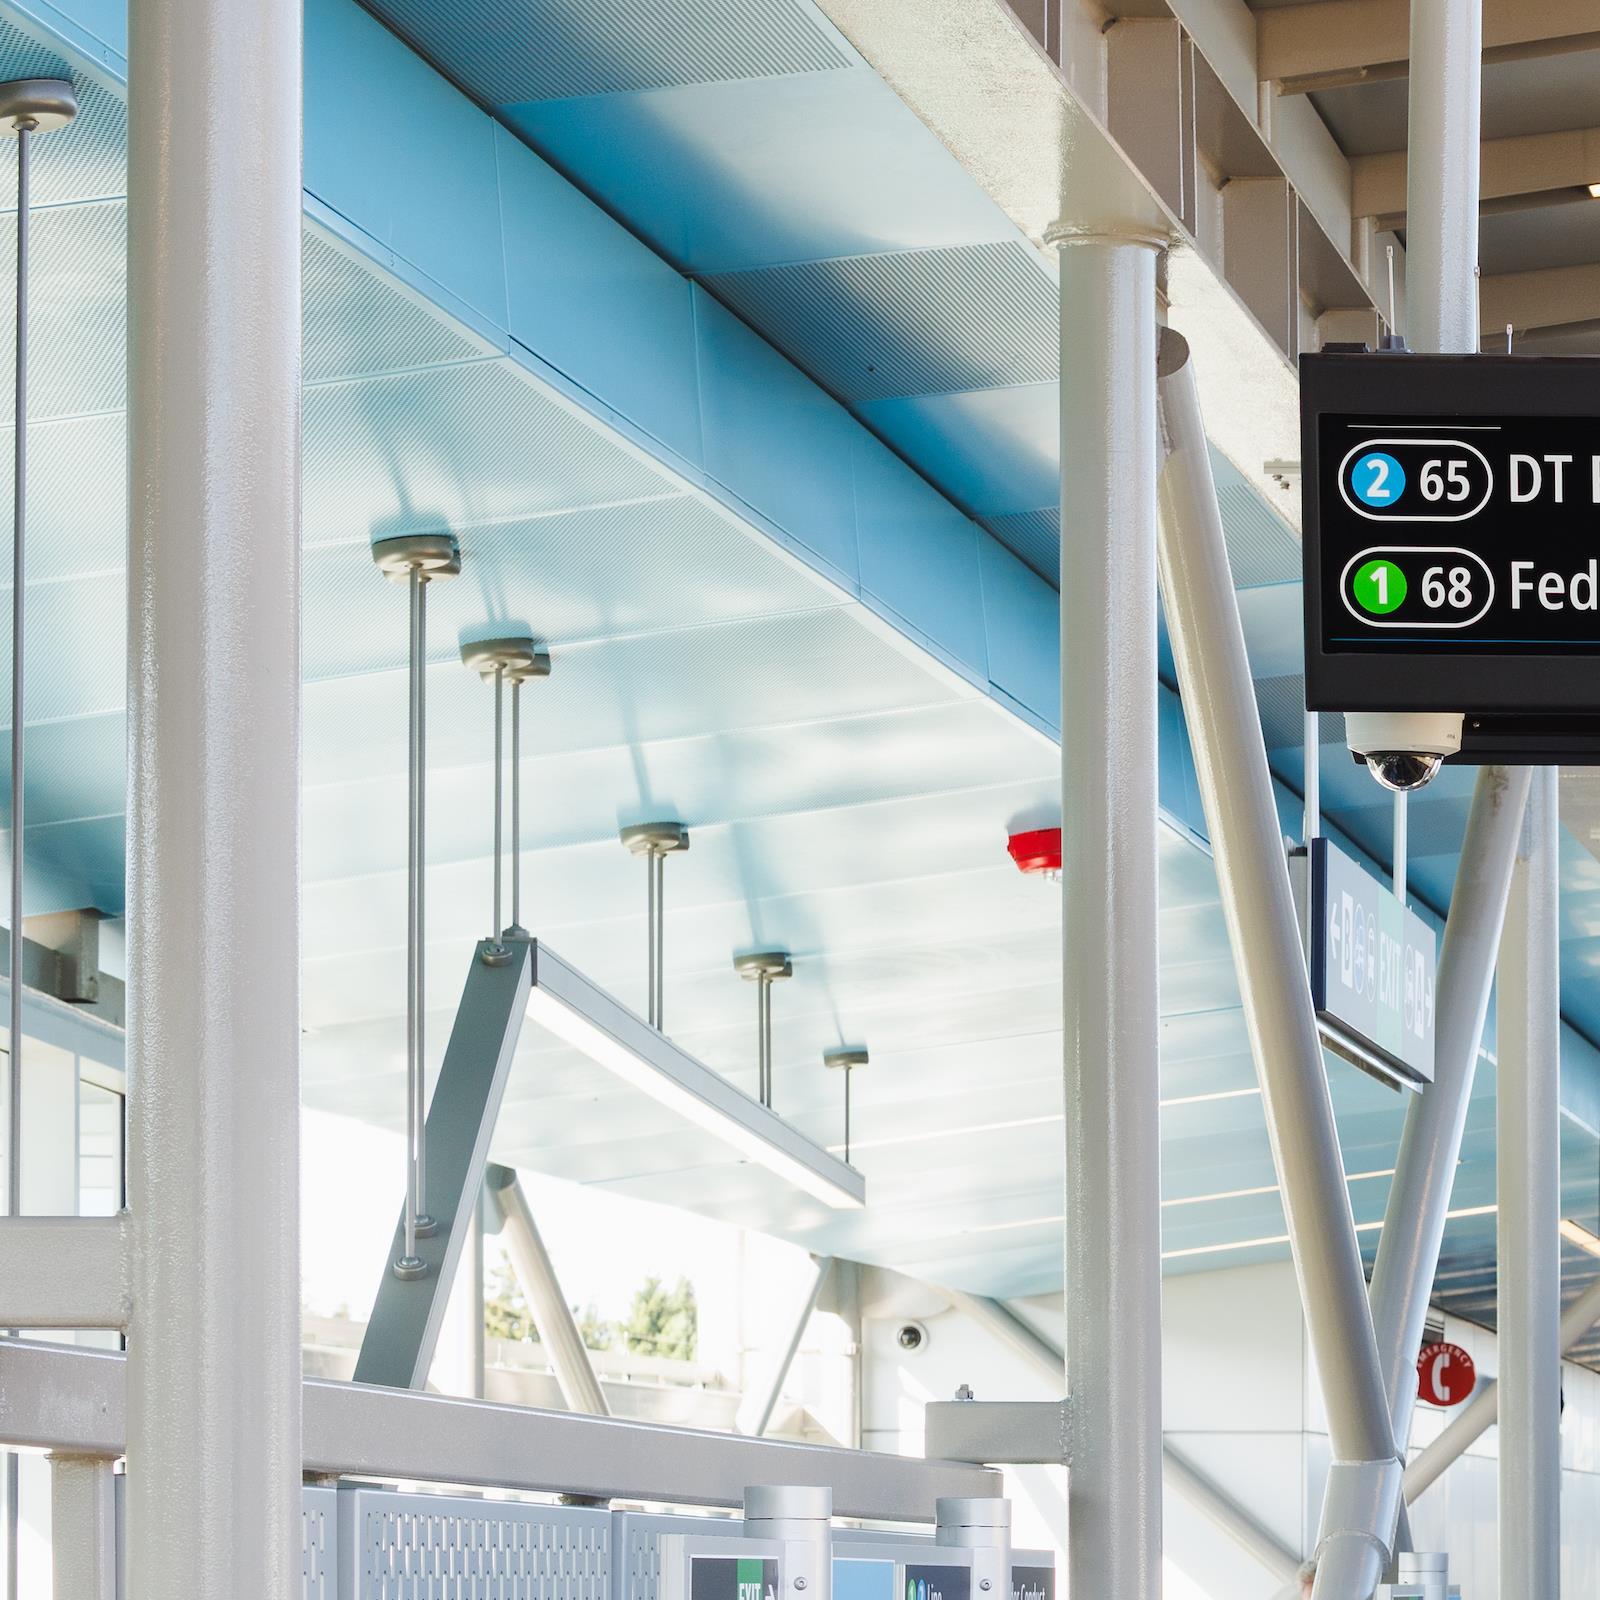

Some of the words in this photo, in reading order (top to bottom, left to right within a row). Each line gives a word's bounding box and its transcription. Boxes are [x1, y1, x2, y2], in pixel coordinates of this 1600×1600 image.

[1366, 458, 1391, 498] 2
[1419, 459, 1471, 502] 65
[1509, 453, 1573, 503] DT
[1369, 566, 1389, 605] 1
[1421, 566, 1473, 609] 68
[1511, 559, 1599, 611] Fed
[1379, 931, 1401, 1013] EXIT
